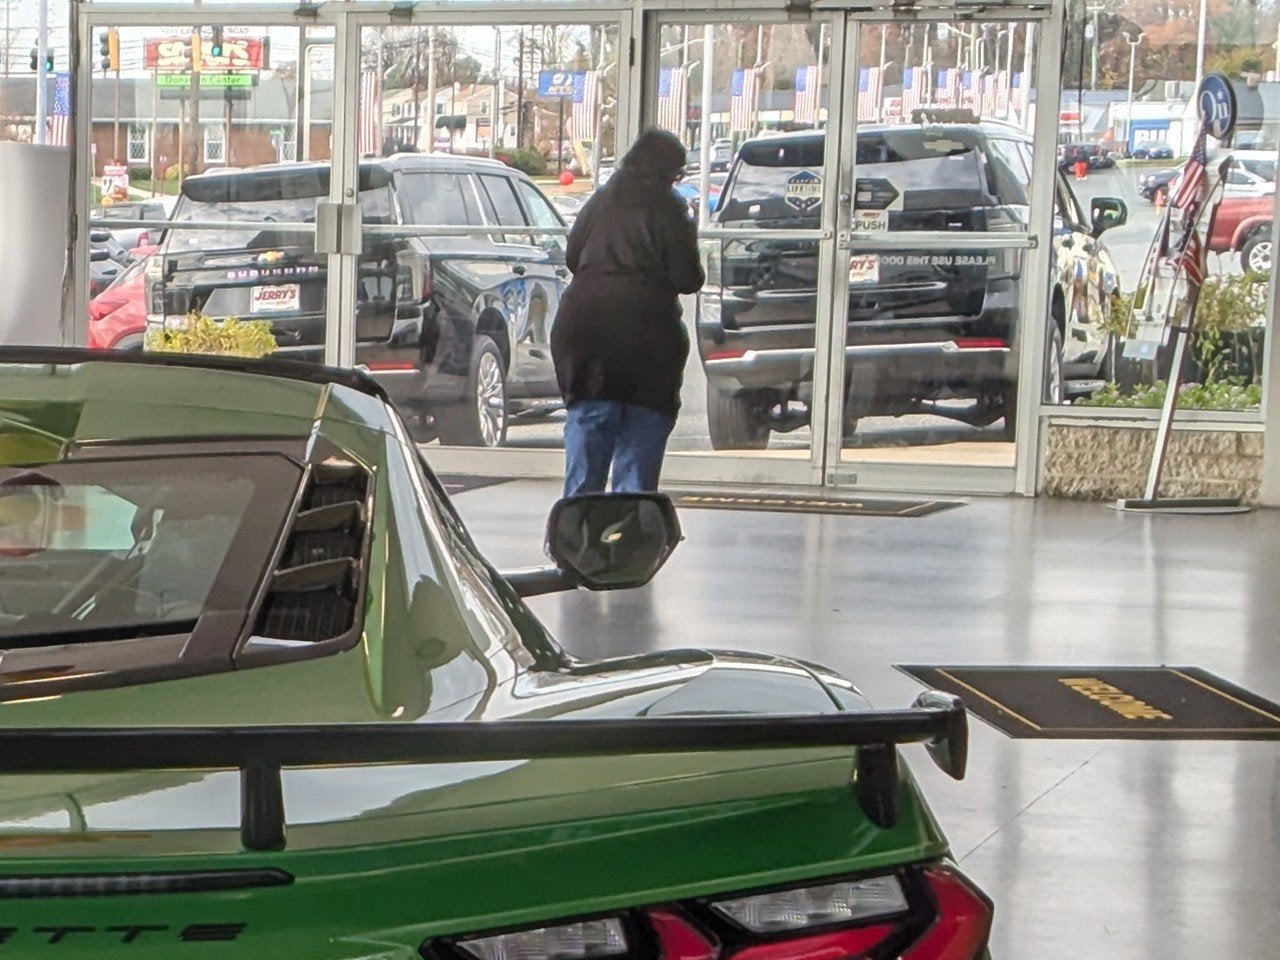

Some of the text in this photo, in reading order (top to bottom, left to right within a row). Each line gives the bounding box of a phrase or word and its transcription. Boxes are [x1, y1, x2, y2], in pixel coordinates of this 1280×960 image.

[856, 220, 886, 230] PUSH
[849, 260, 876, 270] RY'S
[254, 289, 297, 301] JERRY'S
